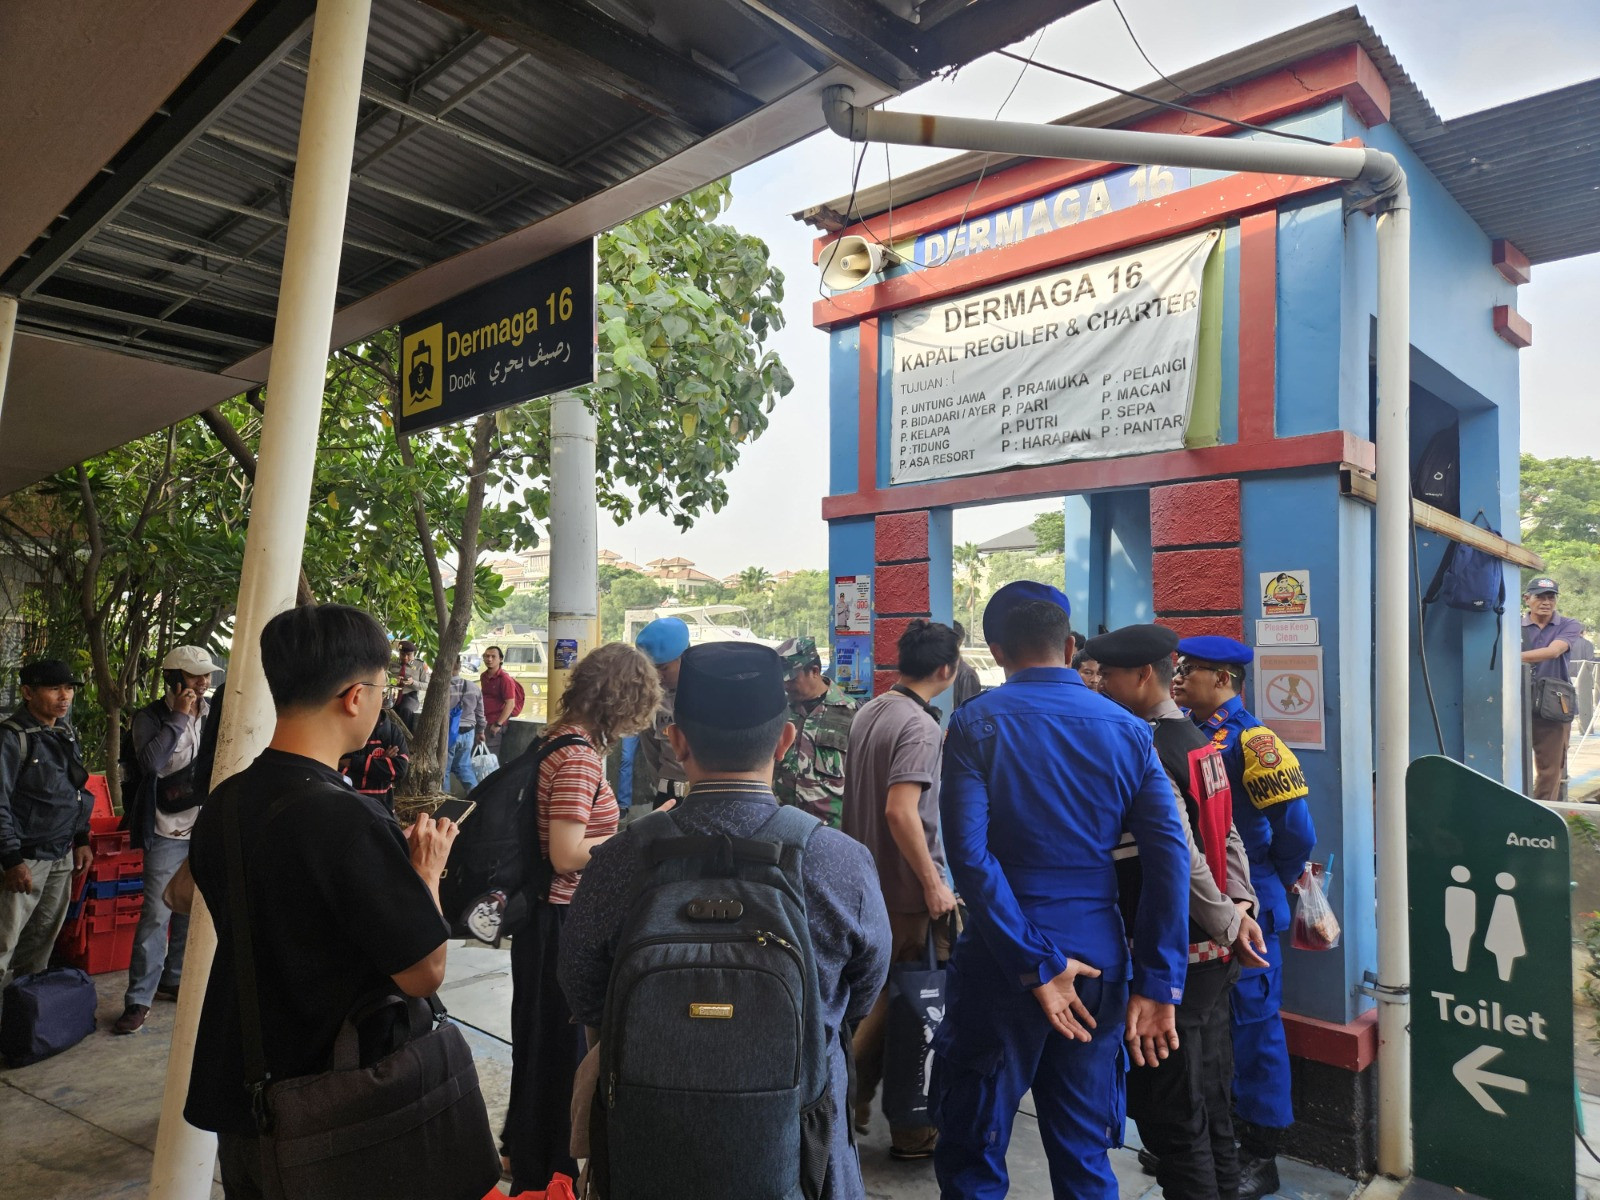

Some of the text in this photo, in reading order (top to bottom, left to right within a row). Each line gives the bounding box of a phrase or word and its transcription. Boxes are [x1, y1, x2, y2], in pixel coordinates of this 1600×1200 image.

[924, 164, 1174, 265] DERMAGA 16
[945, 261, 1143, 333] DERMAGA 16
[447, 286, 573, 363] Dermaga 16
[901, 289, 1198, 373] KAPAL REGULER & CHARTER
[489, 341, 571, 386] رصيف بحري
[1123, 357, 1186, 382] PELANGI
[449, 369, 476, 393] Dock
[1002, 372, 1089, 400] P. PRAMUKA
[1102, 379, 1171, 403] P. MACAN
[911, 397, 953, 414] UNTUNG
[956, 391, 986, 406] JAWA
[1001, 397, 1048, 418] P. PARI
[1101, 401, 1156, 421] P. SEPA
[911, 410, 960, 427] BIDADARI
[967, 403, 996, 418] AYER
[1001, 414, 1058, 435] P. PUTRI
[910, 425, 951, 441] KELAPA
[1022, 427, 1091, 450] HARAPAN
[909, 456, 930, 468] ASA
[933, 449, 975, 465] RESORT
[1264, 622, 1309, 633] Please Keep
[1275, 633, 1298, 642] Clean
[1506, 832, 1556, 850] Ancol
[1430, 990, 1548, 1041] Toilet
